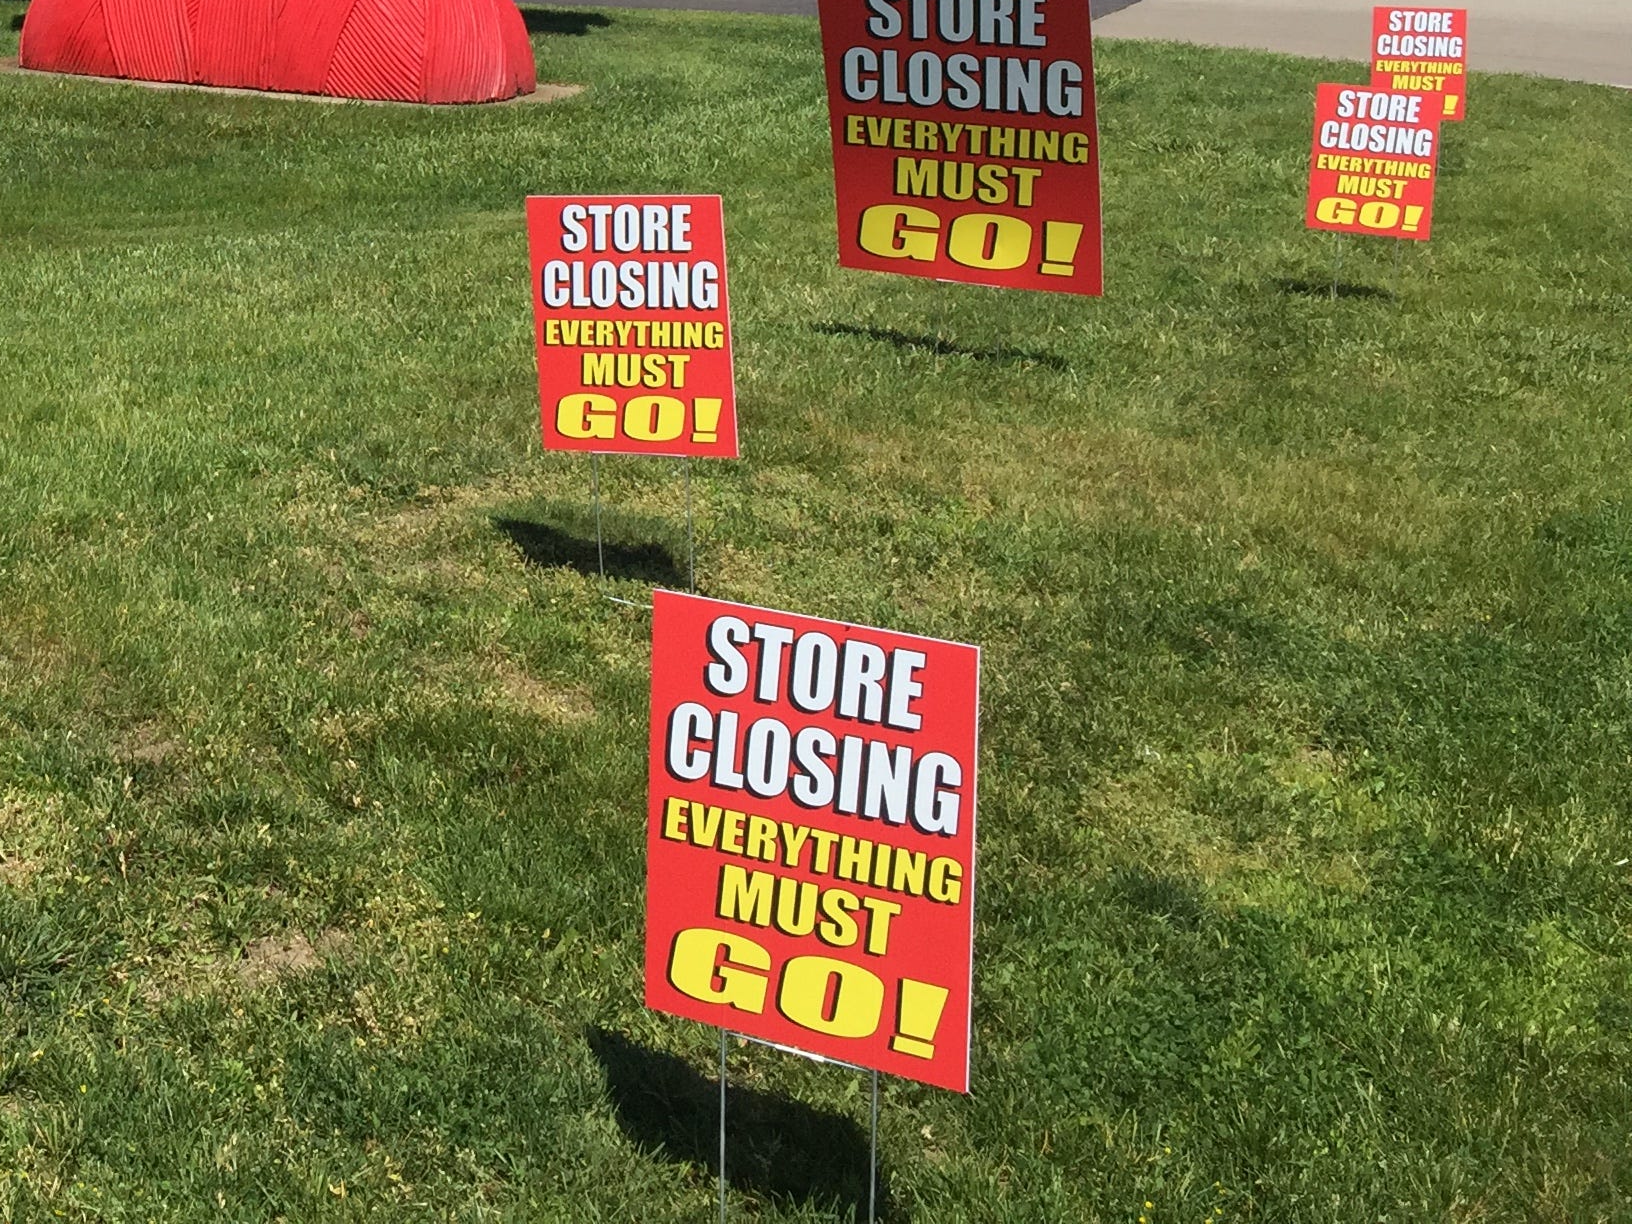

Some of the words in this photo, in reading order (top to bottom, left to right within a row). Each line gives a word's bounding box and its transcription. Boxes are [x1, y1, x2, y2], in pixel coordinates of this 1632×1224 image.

[1377, 34, 1463, 58] CLOSING
[1389, 10, 1453, 33] STORE
[842, 47, 1083, 117] CLOSING
[1376, 59, 1463, 75] EVERYTHING
[1392, 74, 1446, 91] MUST
[1337, 90, 1422, 123] STORE
[845, 114, 1089, 164] EVERYTHING
[1320, 121, 1433, 157] CLOSING
[894, 157, 1042, 206] MUST
[1317, 153, 1432, 179] EVERYTHING
[1337, 174, 1408, 199] MUST
[561, 204, 693, 253] STORE
[1315, 197, 1424, 232] GO!
[857, 204, 1084, 276] GO!
[543, 259, 719, 310] CLOSING
[544, 319, 724, 349] EVERYTHING
[581, 352, 691, 389] MUST
[556, 393, 723, 443] GO!
[707, 614, 927, 732] STORE
[667, 701, 962, 837] CLOSING
[663, 796, 964, 905] EVERYTHING
[718, 864, 902, 956] MUST
[669, 927, 950, 1060] GO!
